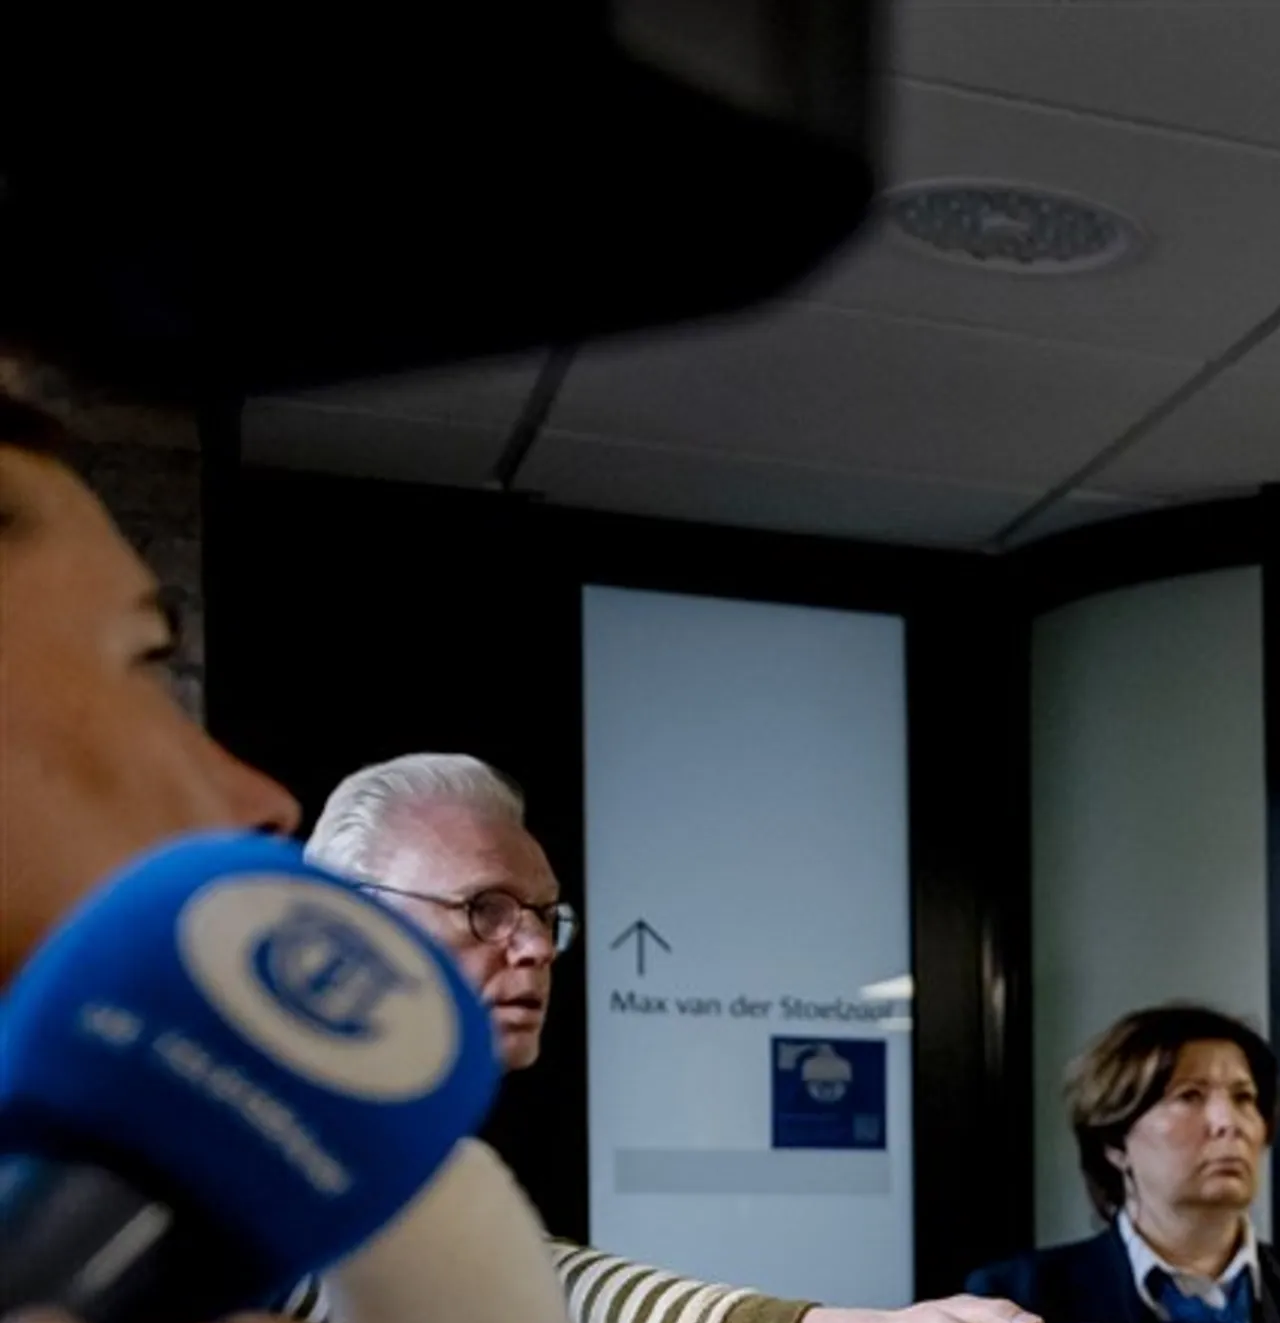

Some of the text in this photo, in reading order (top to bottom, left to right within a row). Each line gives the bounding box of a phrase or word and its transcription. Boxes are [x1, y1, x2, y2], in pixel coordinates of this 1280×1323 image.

[610, 990, 668, 1014] Max
[675, 997, 722, 1017] van
[729, 994, 771, 1019] der
